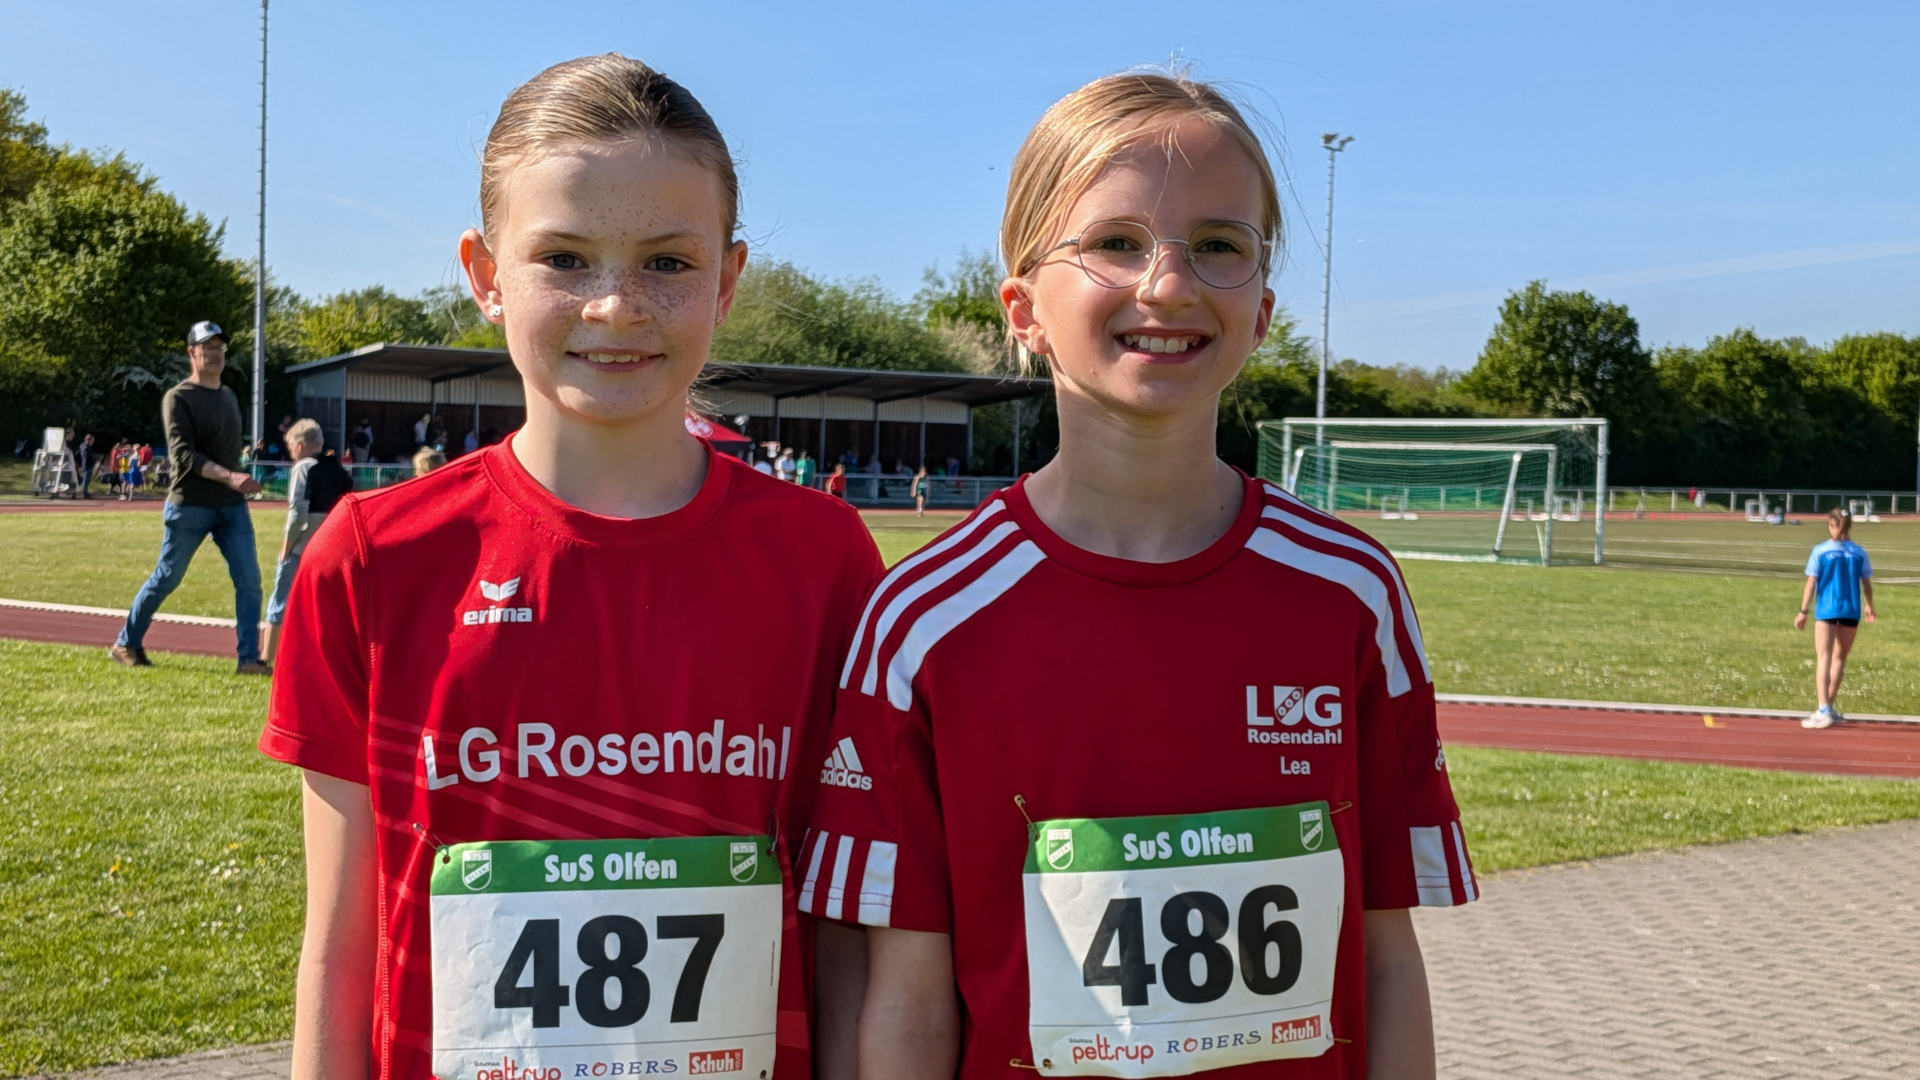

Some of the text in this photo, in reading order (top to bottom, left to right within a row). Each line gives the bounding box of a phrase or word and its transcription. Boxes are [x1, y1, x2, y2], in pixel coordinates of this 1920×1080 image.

[463, 604, 532, 625] erima
[1247, 728, 1342, 744] Rosendahl
[423, 719, 792, 790] LG Rosendahl
[1280, 756, 1311, 775] Lea
[820, 767, 873, 791] adidas
[1122, 826, 1254, 862] SuS Olfen
[544, 851, 678, 883] SuS Olfen
[1083, 884, 1303, 1007] 486
[494, 914, 725, 1029] 487
[1166, 1030, 1262, 1053] ROBERS
[1273, 1020, 1314, 1043] Schuh
[1072, 1033, 1154, 1065] pettrup
[477, 1056, 562, 1080] pettrup
[573, 1059, 678, 1077] ROBERS
[691, 1052, 734, 1074] Schuh
